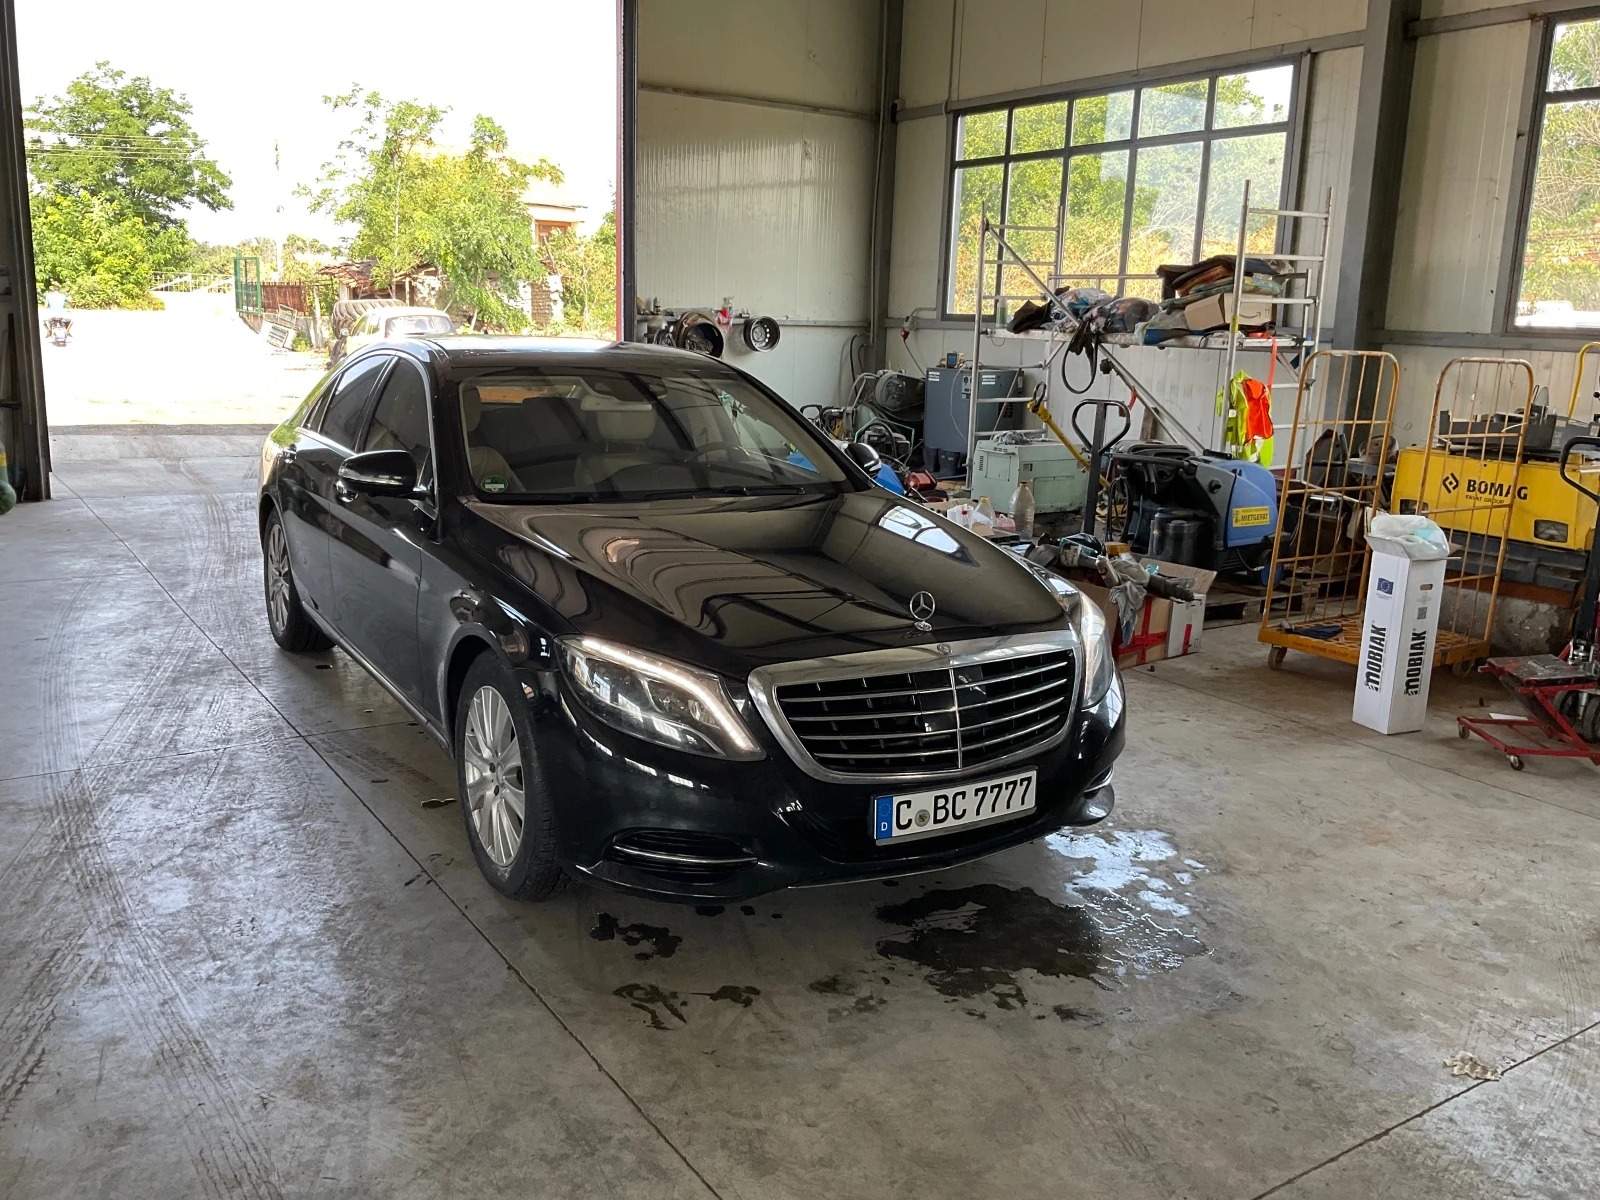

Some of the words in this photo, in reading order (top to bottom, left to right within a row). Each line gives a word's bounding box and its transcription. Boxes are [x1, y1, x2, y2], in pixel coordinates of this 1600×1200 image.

[1467, 479, 1528, 500] BOMAG
[1365, 624, 1386, 692] MOBIAK
[1404, 630, 1426, 695] MOBIAK
[881, 822, 888, 831] D
[895, 800, 912, 830] C
[933, 791, 966, 824] BC
[974, 776, 1032, 816] 7777
